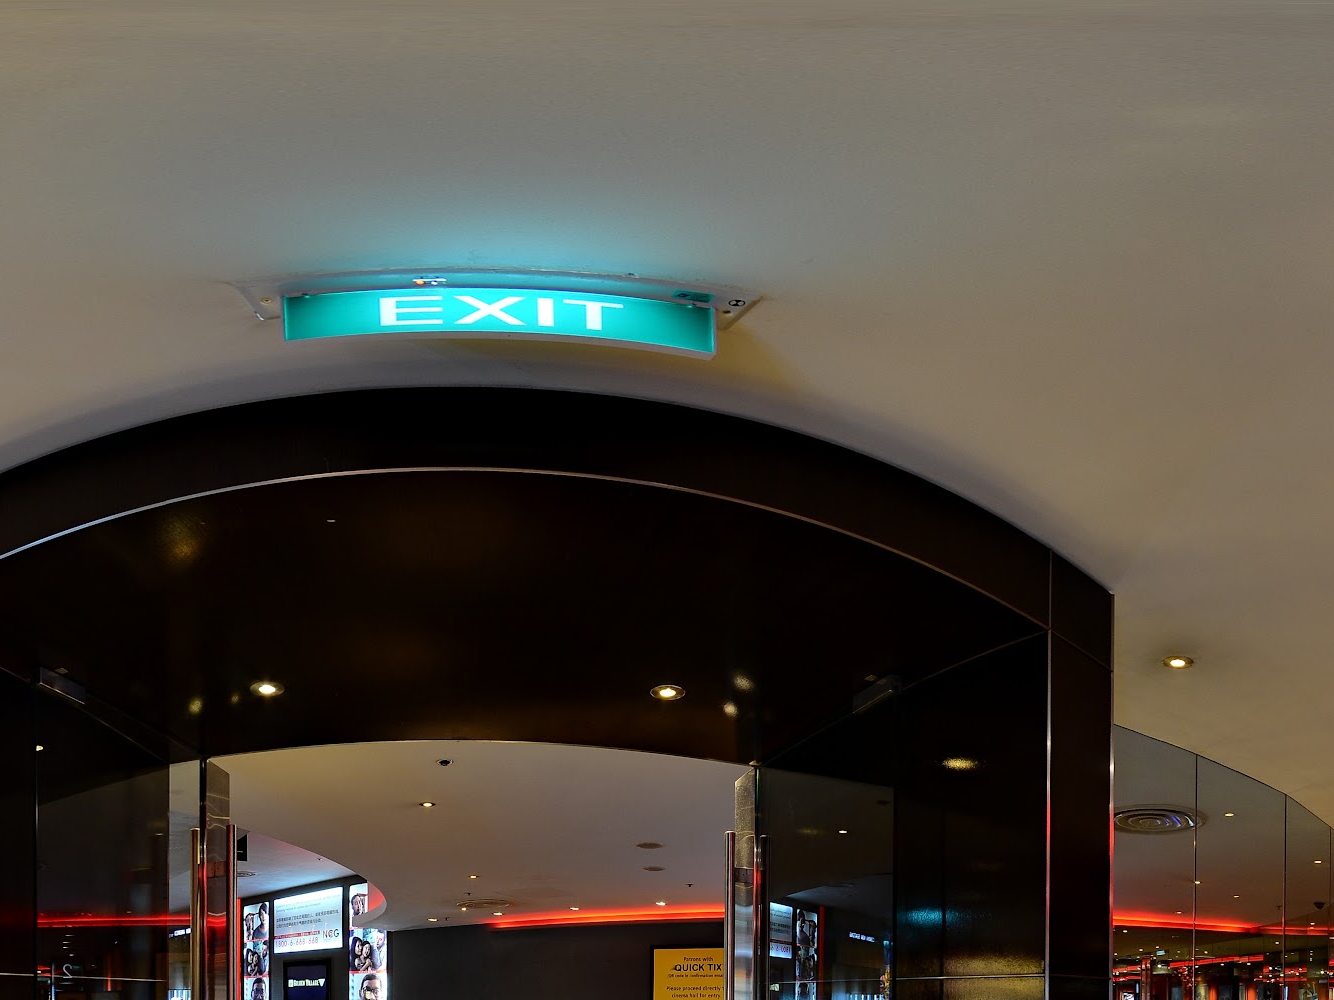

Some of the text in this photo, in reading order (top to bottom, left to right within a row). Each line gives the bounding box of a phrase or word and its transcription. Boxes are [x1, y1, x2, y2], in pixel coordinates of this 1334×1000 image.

[379, 295, 624, 331] EXIT
[674, 963, 722, 972] QUICK TIX
